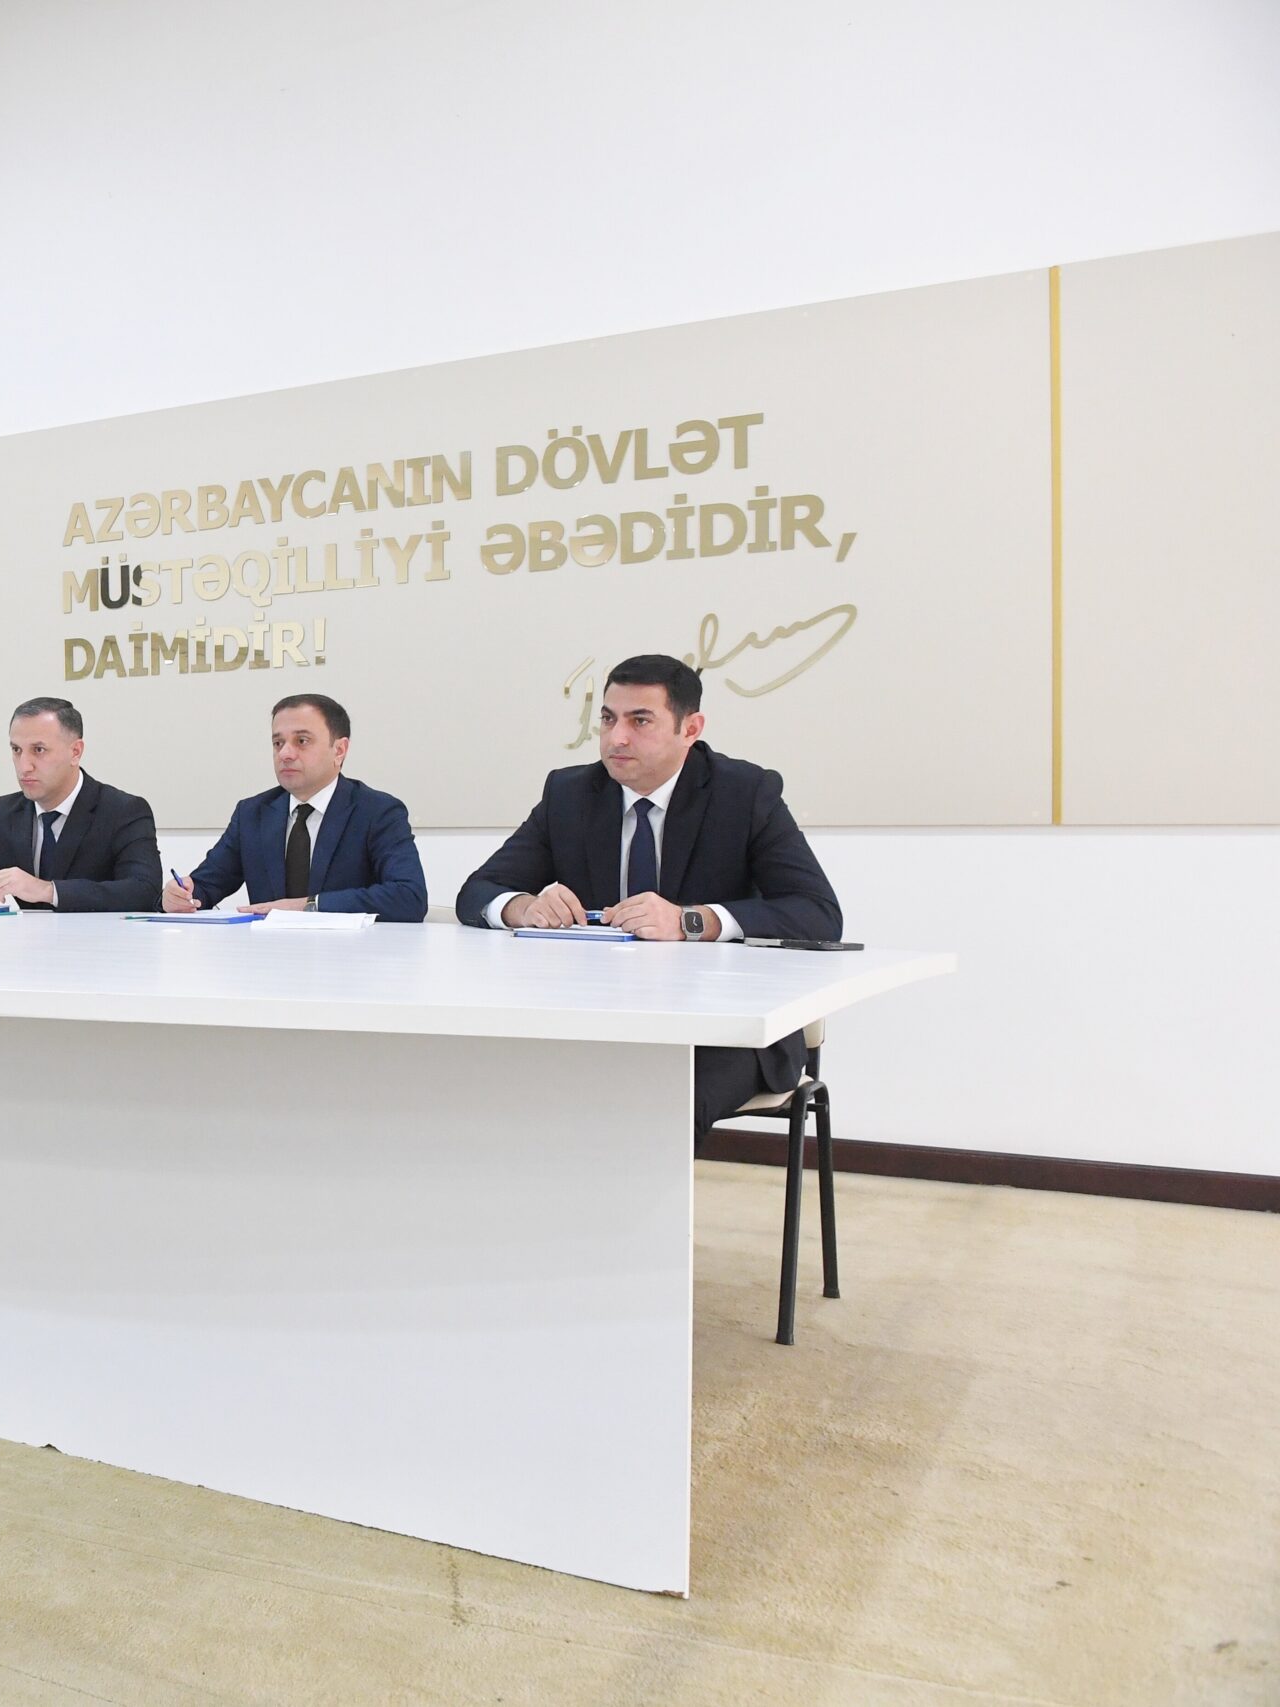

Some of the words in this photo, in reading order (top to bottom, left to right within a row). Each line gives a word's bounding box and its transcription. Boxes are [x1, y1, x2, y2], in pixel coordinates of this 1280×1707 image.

[63, 451, 472, 546] AZƏRBAYCANIN
[496, 414, 764, 496] DÖVLƏT
[63, 521, 451, 613] MÜSTƏQİLLİYİ
[481, 486, 858, 575] ƏBƏDİDİR,
[64, 614, 327, 681] DAİMİDİR!
